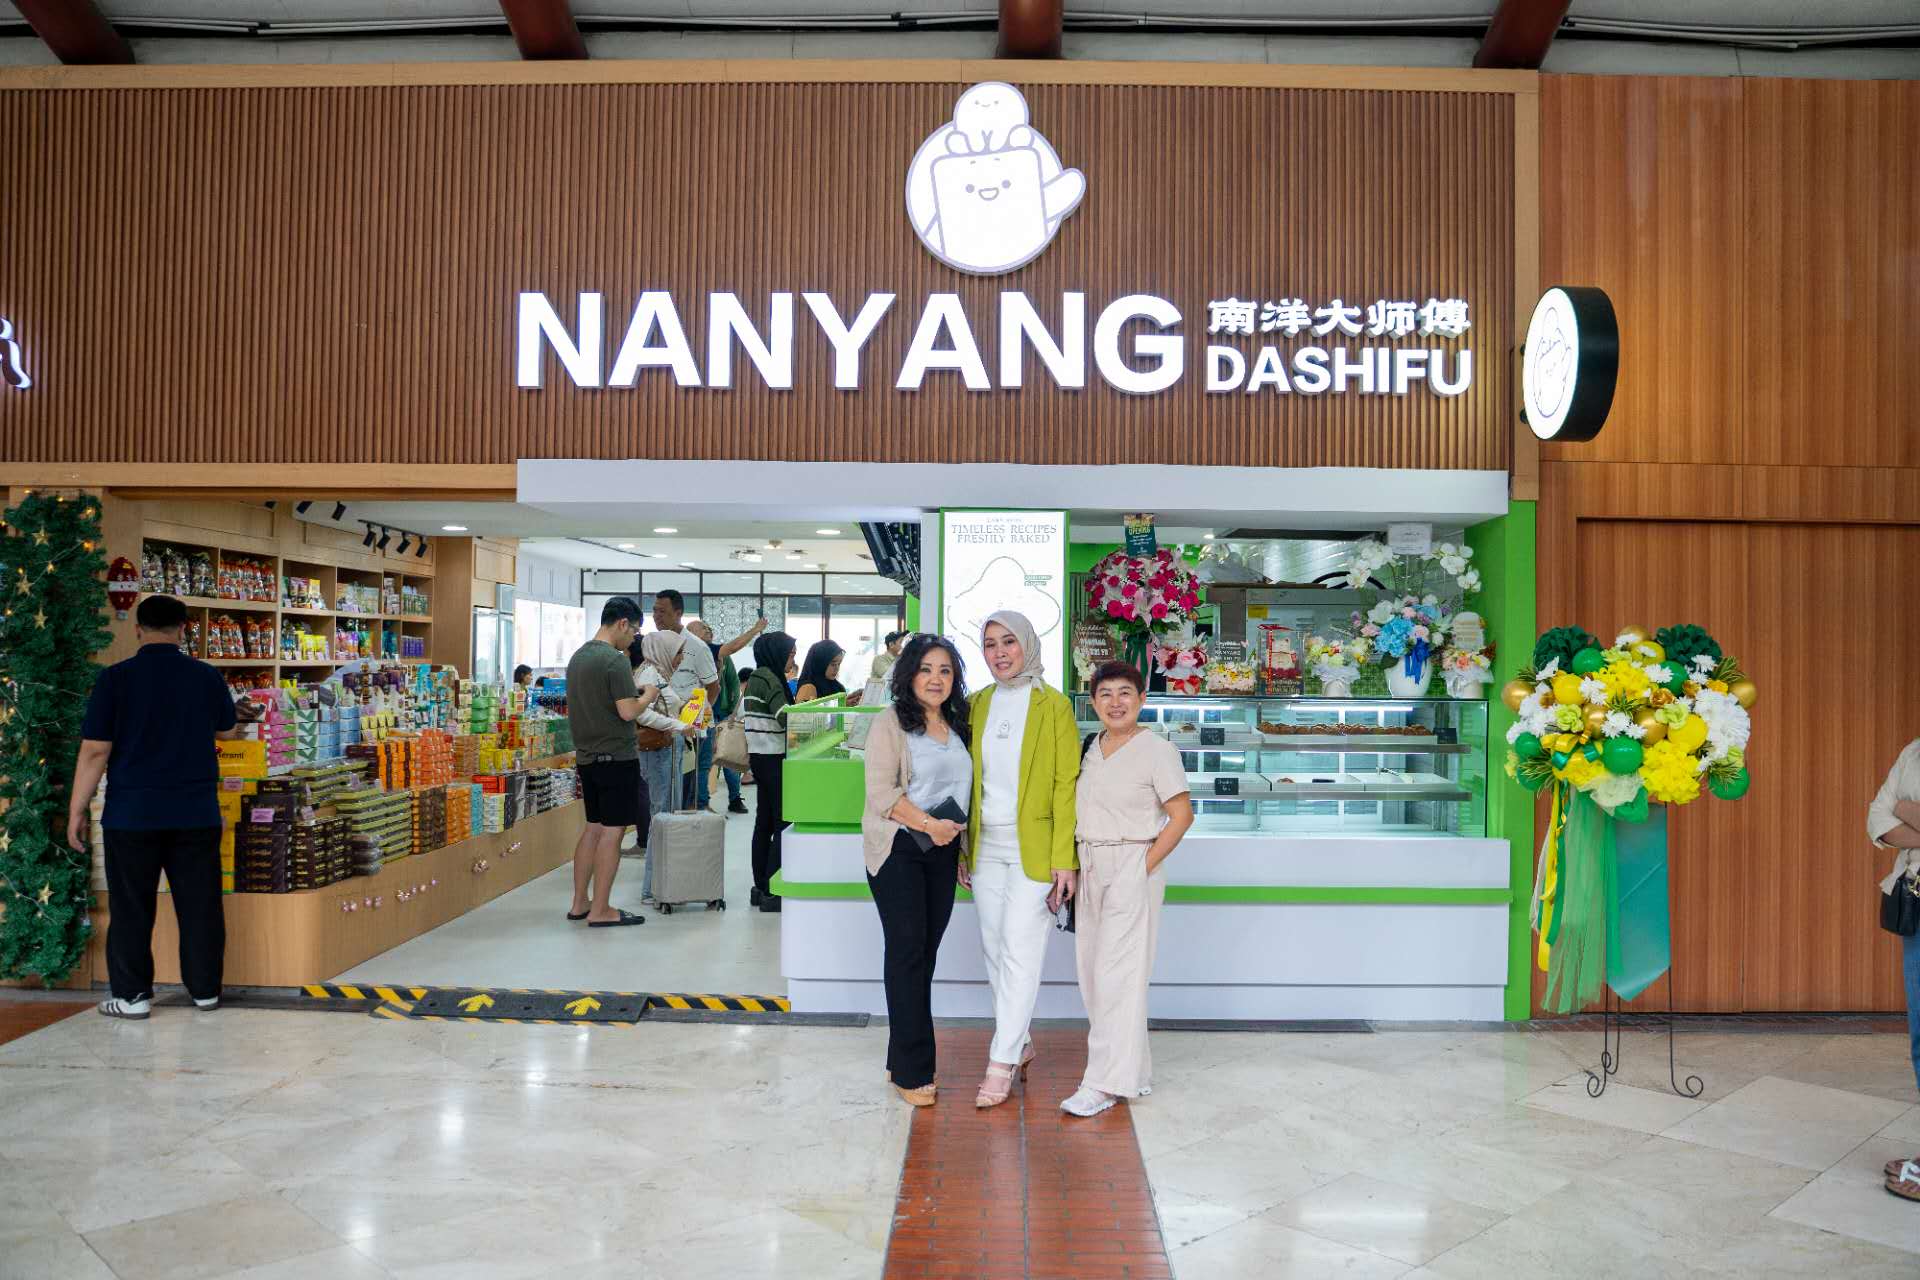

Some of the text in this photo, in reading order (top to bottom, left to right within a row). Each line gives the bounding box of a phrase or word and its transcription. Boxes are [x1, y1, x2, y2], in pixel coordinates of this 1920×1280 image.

[1207, 297, 1472, 339] 南洋大师傅
[516, 290, 1185, 394] NANYANG
[1206, 344, 1473, 396] DASHIFU
[951, 524, 1057, 534] TIMELESS RECIPES
[957, 534, 1051, 544] FRESHLY BAKED
